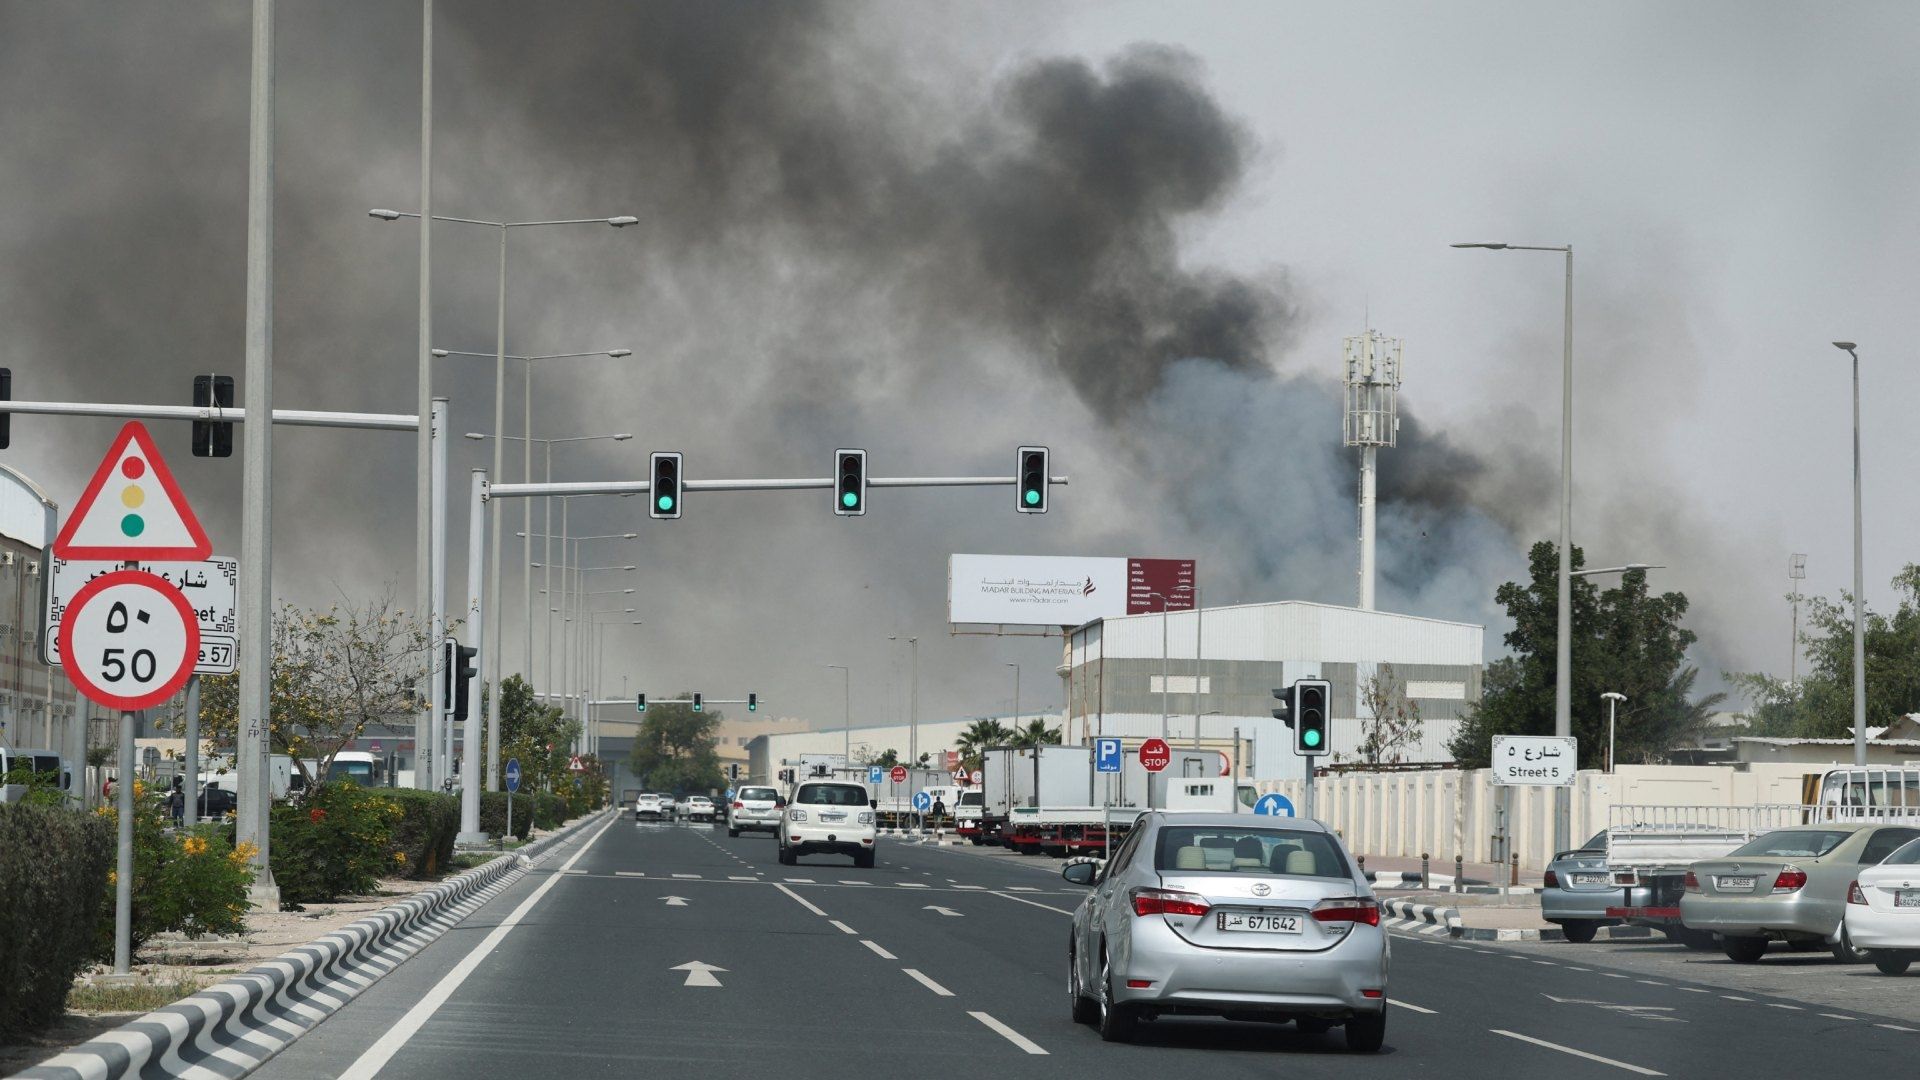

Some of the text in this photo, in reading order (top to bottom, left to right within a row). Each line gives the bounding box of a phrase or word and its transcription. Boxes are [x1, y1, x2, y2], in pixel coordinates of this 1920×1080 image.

[1010, 587, 1041, 595] BUILDING
[211, 646, 230, 663] 57
[101, 648, 157, 683] 50
[1101, 741, 1117, 762] P
[1146, 745, 1164, 754] قف
[1524, 746, 1561, 761] شارع
[1144, 758, 1168, 767] STOP
[872, 767, 880, 778] P
[1509, 766, 1559, 778] Street 5
[1248, 916, 1296, 931] 671642
